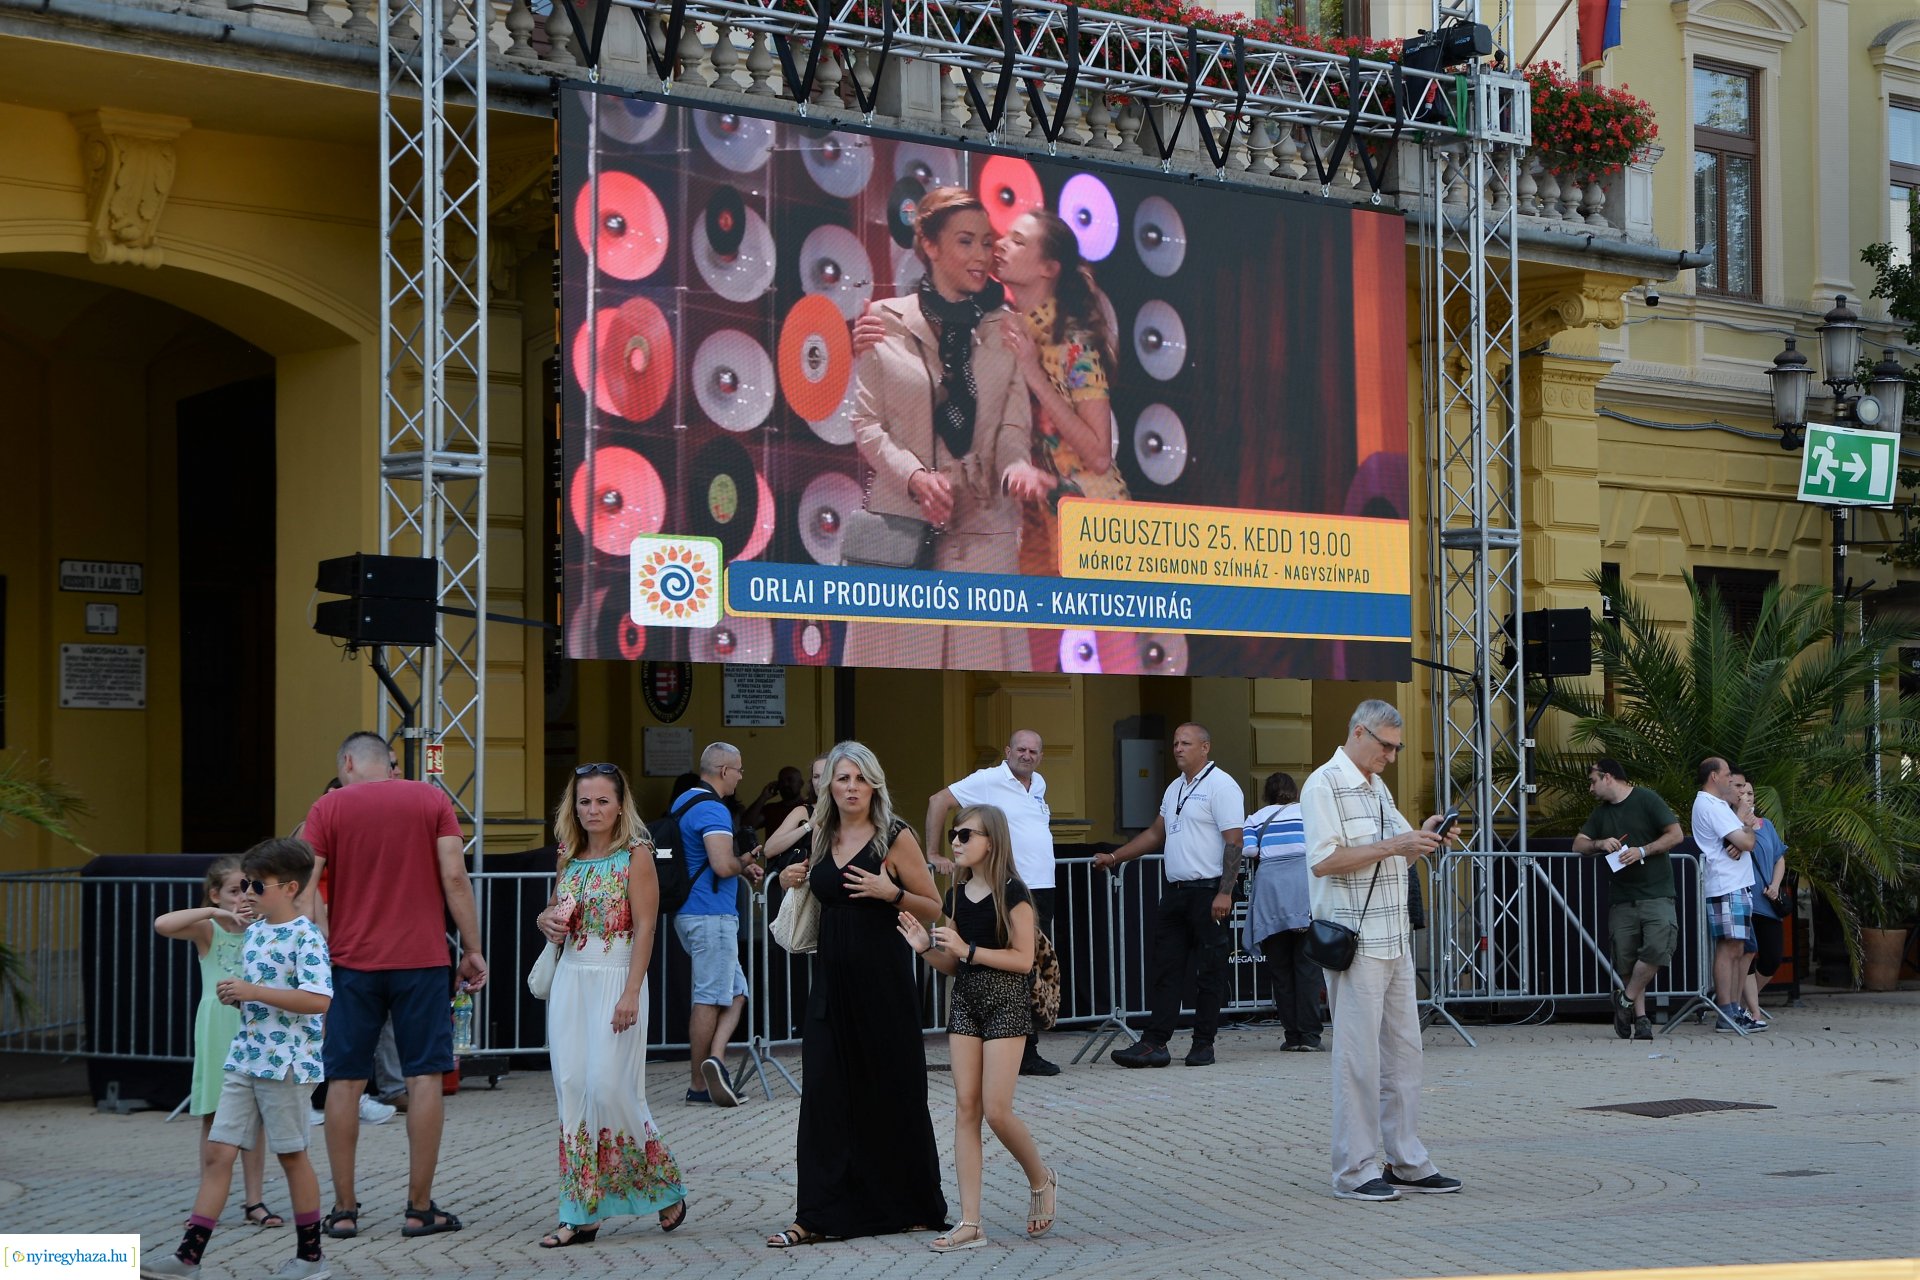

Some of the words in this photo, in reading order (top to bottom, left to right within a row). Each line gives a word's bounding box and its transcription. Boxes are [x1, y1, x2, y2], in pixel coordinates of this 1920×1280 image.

[1079, 515, 1200, 548] AUGUSZTUS
[1207, 524, 1237, 551] 25.
[1244, 526, 1292, 554] KEDD
[1299, 530, 1351, 557] 19.00
[1079, 550, 1132, 572] MÓRICZ
[1138, 556, 1208, 576] ZSIGMOND
[1213, 557, 1269, 579] SZÍNHÁZ
[1284, 563, 1370, 584] NAGYSZÍNPAD
[750, 577, 814, 604] ORLAI
[823, 580, 960, 611] PRODUKCIÓS
[967, 587, 1029, 613] IRODA
[1052, 591, 1192, 620] KAKTUSZVIRÁG
